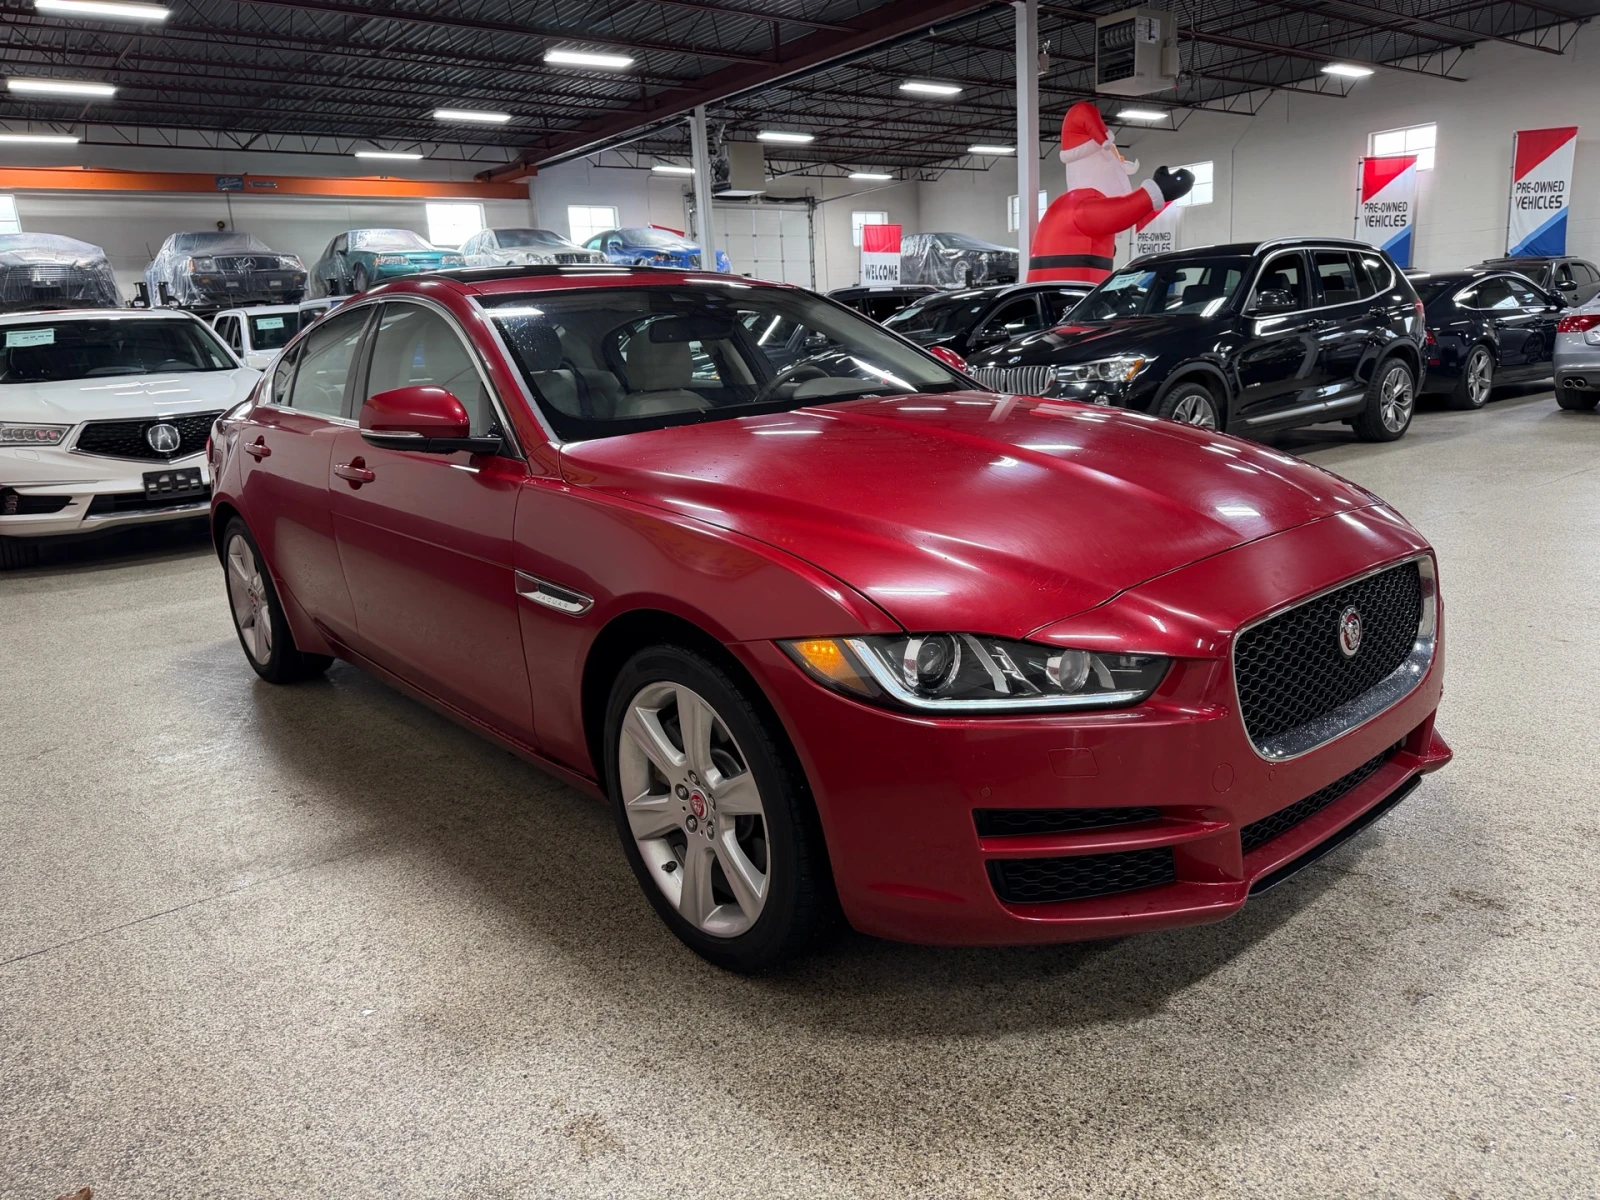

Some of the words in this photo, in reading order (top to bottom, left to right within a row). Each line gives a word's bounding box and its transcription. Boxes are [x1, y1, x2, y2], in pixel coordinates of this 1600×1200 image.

[1516, 181, 1564, 193] PRE-OWNED
[1364, 202, 1408, 213] PRE-OWNED
[1515, 195, 1563, 210] VEHICLES
[1364, 215, 1407, 228] VEHICLES
[1137, 232, 1171, 241] PRE-OWNED
[865, 264, 898, 280] WELCOME
